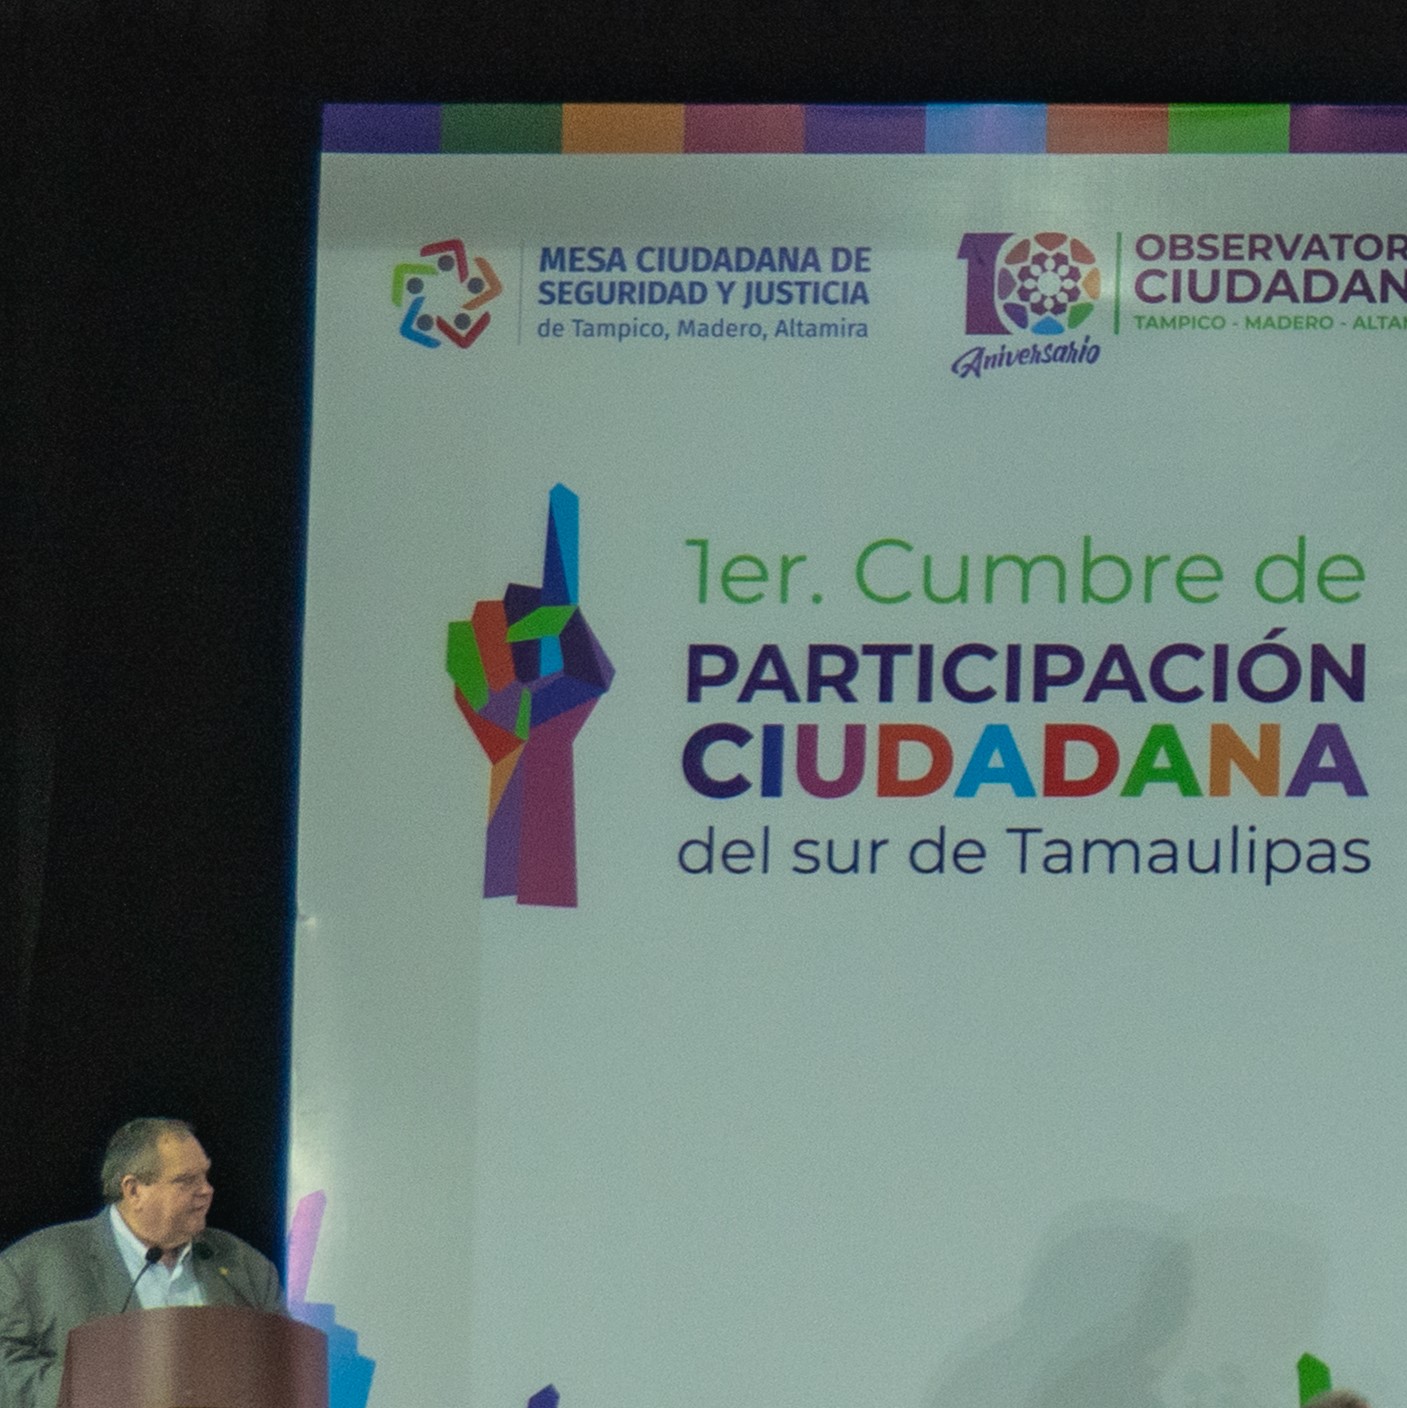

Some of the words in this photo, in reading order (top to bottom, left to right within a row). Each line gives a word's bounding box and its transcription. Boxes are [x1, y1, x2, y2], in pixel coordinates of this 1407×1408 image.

[539, 245, 627, 273] MESA
[636, 245, 821, 273] CIUDADANA
[831, 245, 872, 273] DE
[537, 279, 709, 306] SEGURIDAD
[716, 280, 736, 305] Y
[742, 279, 870, 310] JUSTICIA
[537, 317, 566, 338] de
[570, 318, 670, 343] Tampico,
[676, 317, 768, 341] Madero,
[773, 317, 868, 339] Altamira
[1132, 314, 1227, 330] TAMPICO
[1244, 314, 1334, 331] MADERO
[950, 332, 1101, 379] Aniversario
[685, 538, 823, 605] 1er.
[855, 534, 1224, 605] Cumbre
[1254, 534, 1366, 605] de
[686, 627, 1366, 705] PARTICIPACIÓN
[681, 722, 1369, 800] CIUDADANA
[678, 825, 770, 875] del
[792, 838, 889, 875] sur
[908, 825, 987, 875] de
[1005, 824, 1371, 886] Tamaulipas
